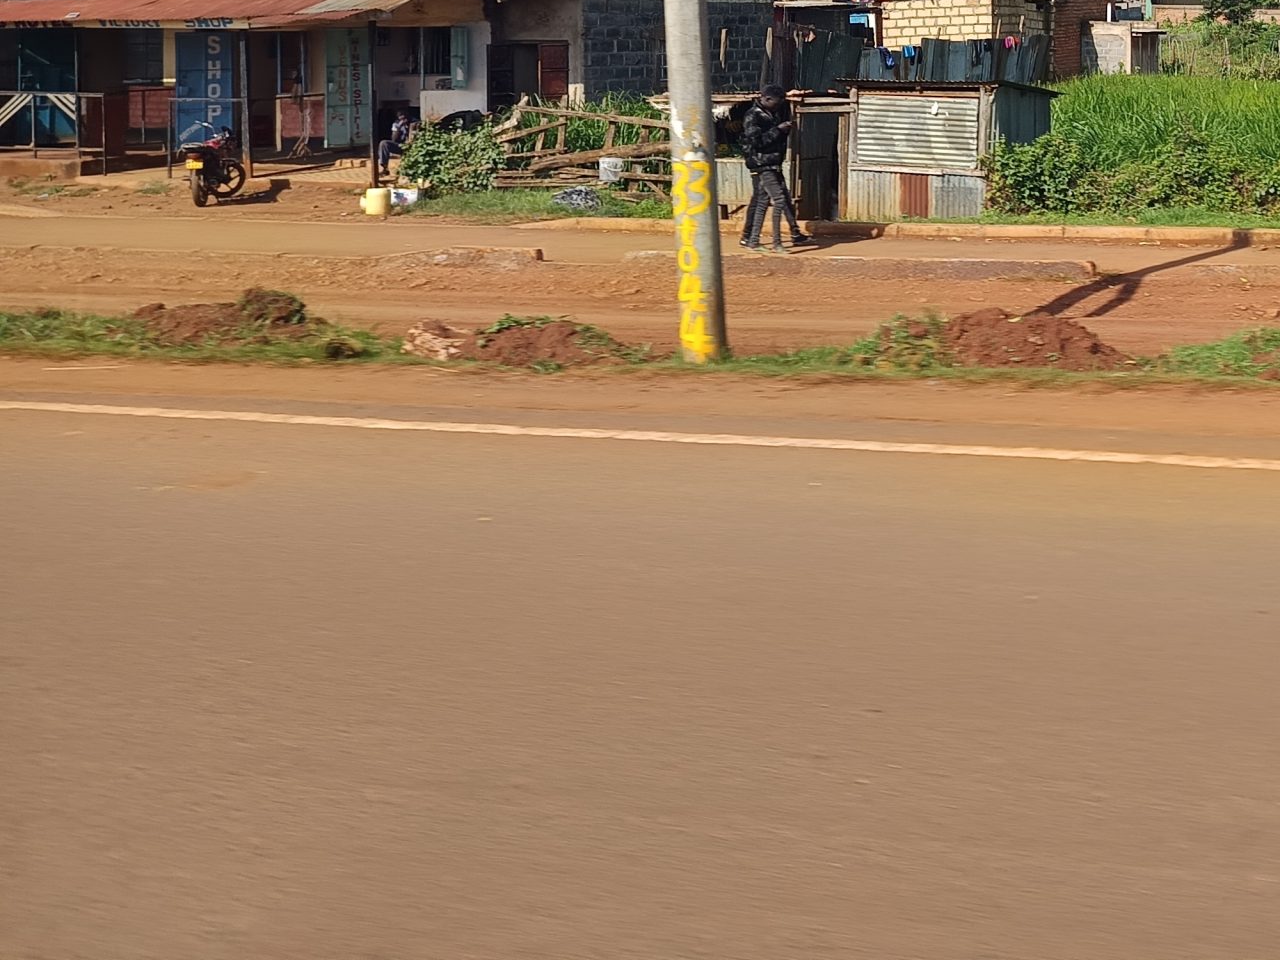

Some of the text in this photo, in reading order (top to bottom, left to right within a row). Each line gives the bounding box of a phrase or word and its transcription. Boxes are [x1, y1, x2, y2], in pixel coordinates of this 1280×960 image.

[184, 17, 234, 28] SHOP
[207, 35, 222, 122] SHOP
[672, 161, 711, 216] 33
